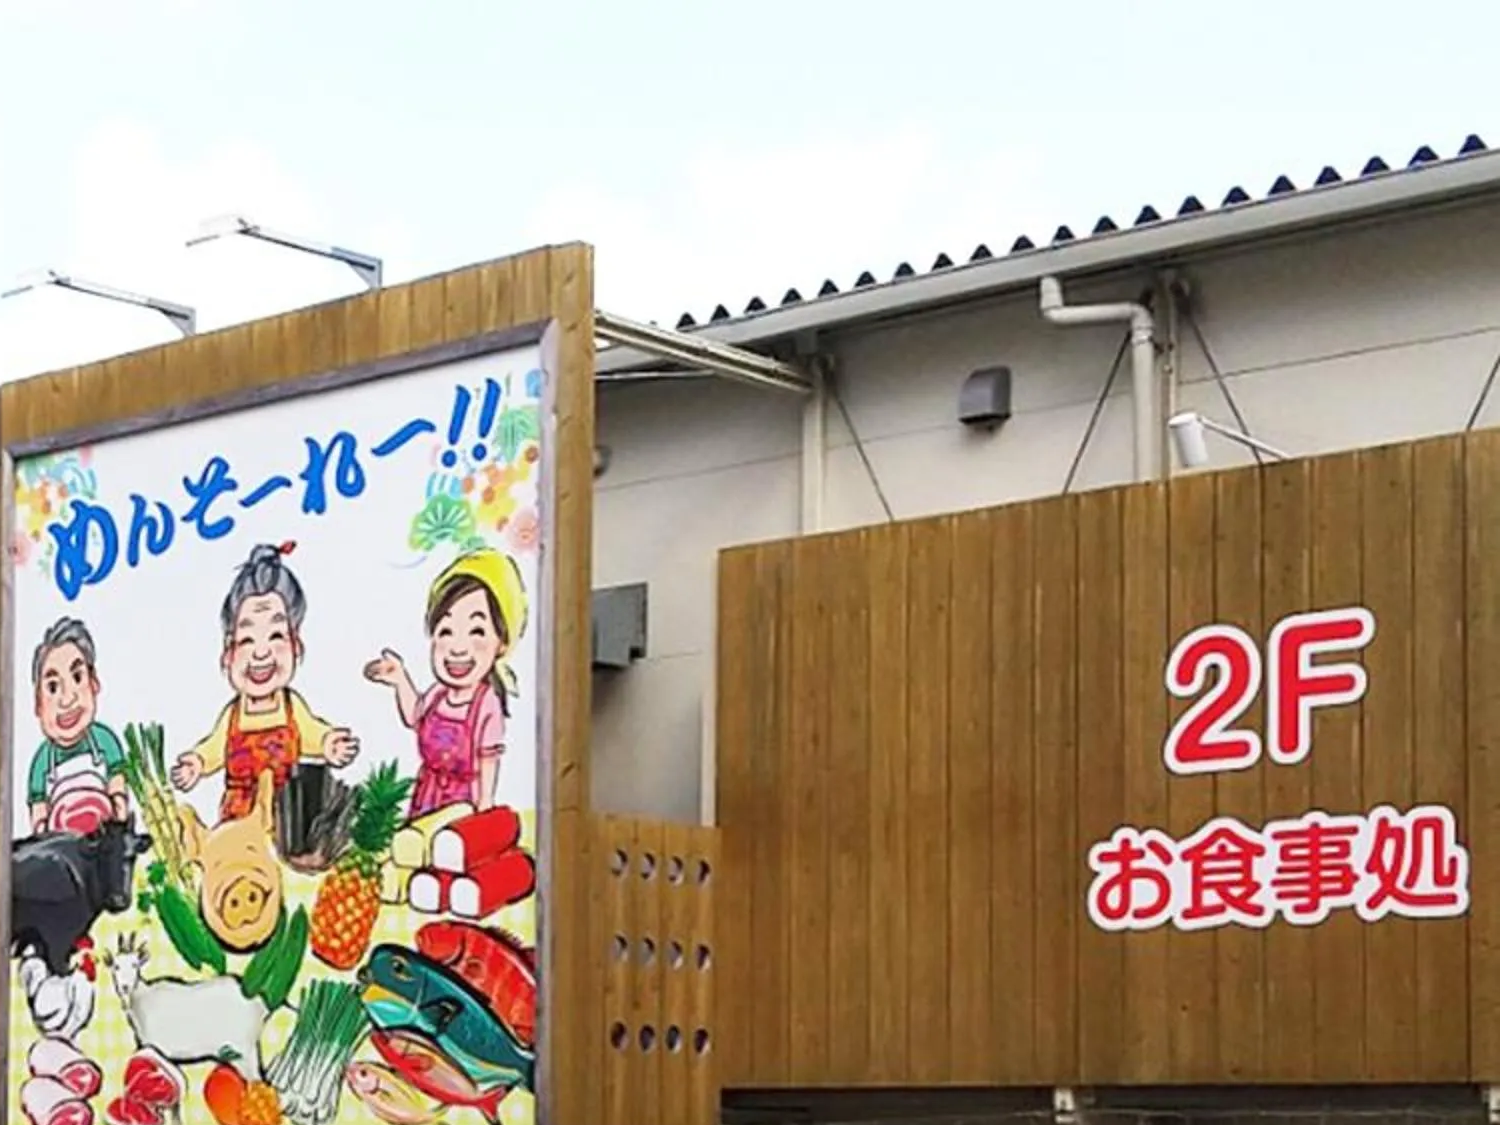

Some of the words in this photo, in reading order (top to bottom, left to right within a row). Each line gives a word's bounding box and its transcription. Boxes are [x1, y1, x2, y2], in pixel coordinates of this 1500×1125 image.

[48, 377, 502, 600] めんそーれー!!
[1167, 610, 1372, 771] 2F
[1092, 808, 1466, 927] お食事処
